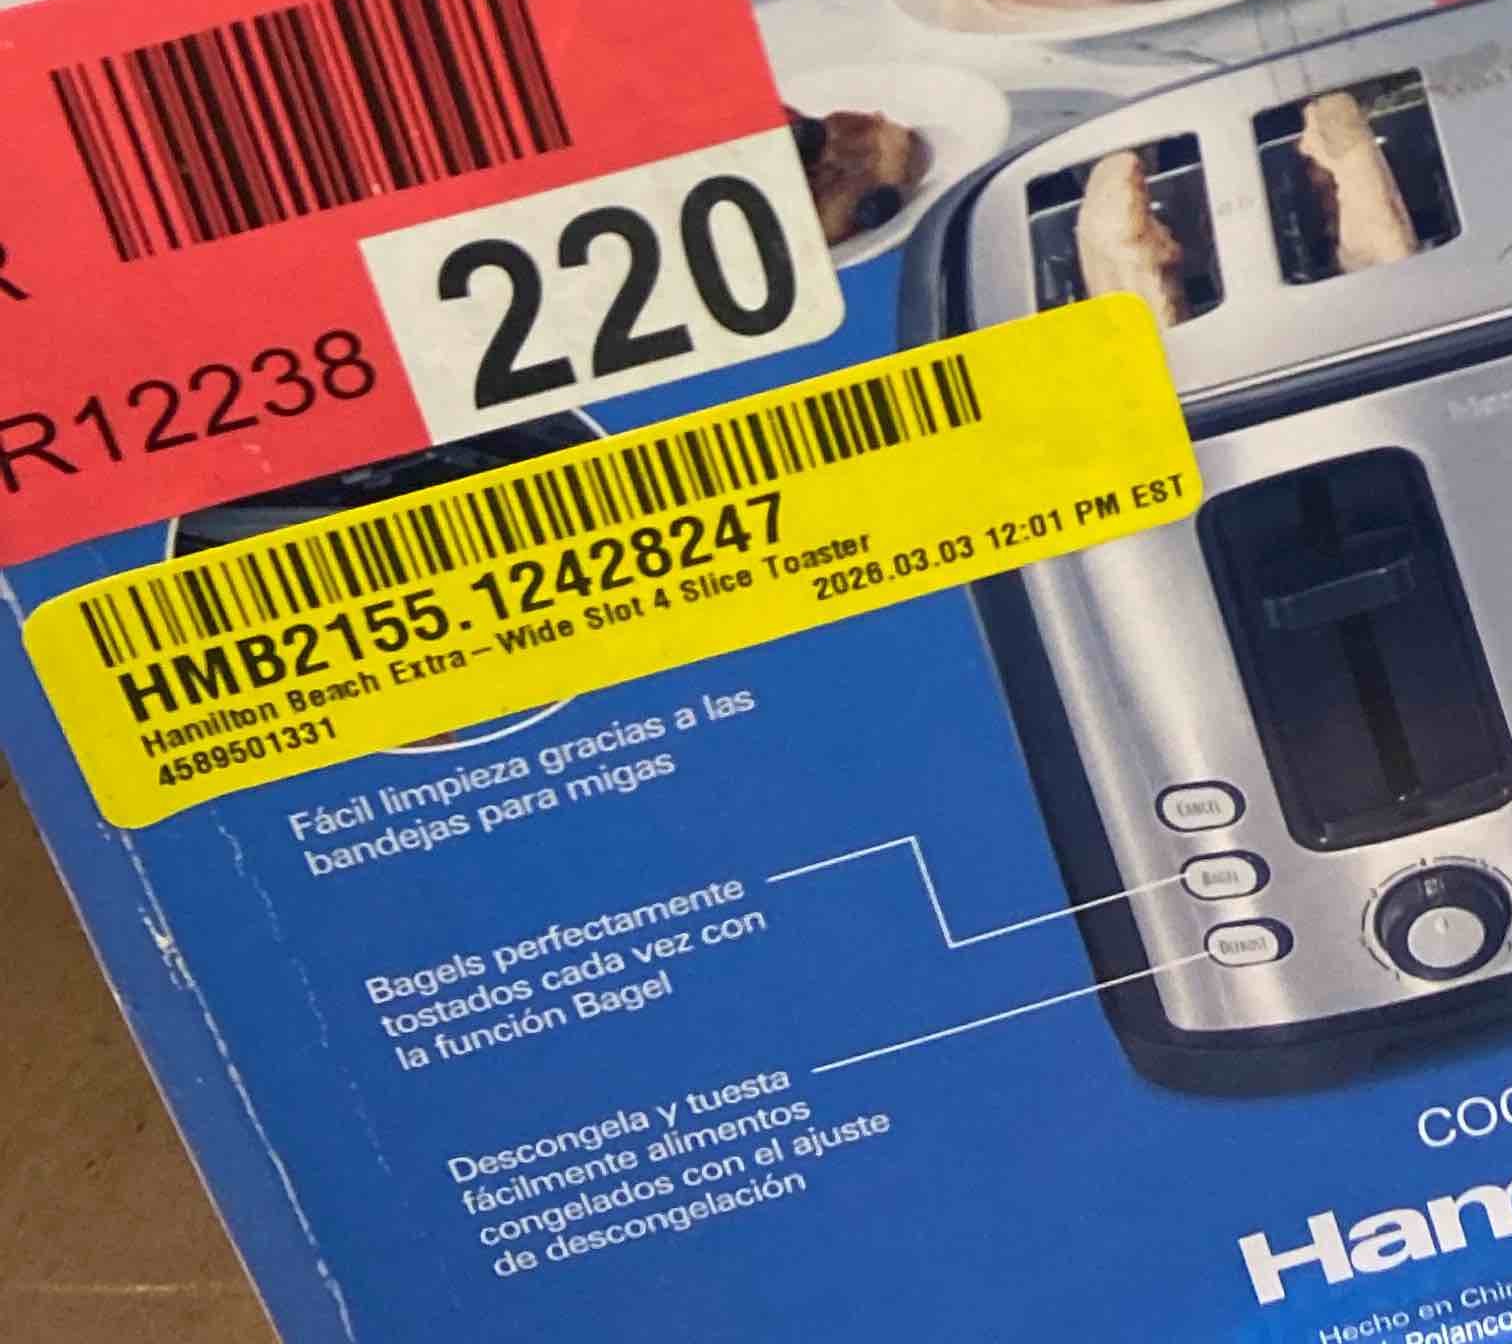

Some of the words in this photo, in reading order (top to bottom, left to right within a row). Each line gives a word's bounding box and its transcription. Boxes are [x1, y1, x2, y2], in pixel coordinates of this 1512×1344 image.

[437, 173, 797, 410] 220
[812, 535, 974, 600] 2026.03.03
[985, 510, 1063, 550] 12:01
[1074, 491, 1121, 526] PM
[1131, 473, 1184, 509] EST
[118, 491, 782, 723] HMB2155.12428247
[140, 700, 278, 758] Hamilton
[286, 672, 381, 713] Beach
[583, 596, 645, 630] Slot
[653, 588, 671, 610] 4
[679, 570, 753, 604] Slice
[762, 532, 871, 580] Toaster
[158, 716, 337, 785] 4589501331
[288, 796, 375, 842] Fácil
[380, 754, 530, 818] limpieza
[539, 714, 666, 774] gracias
[675, 707, 697, 731] a
[703, 686, 755, 721] las
[305, 811, 470, 877] bandejas
[477, 788, 557, 833] para
[567, 748, 675, 800] migas
[365, 951, 485, 1005] Bagels
[495, 875, 745, 971] perfectamente
[381, 976, 533, 1039] tostados
[541, 949, 625, 993] cada
[632, 933, 692, 965] vez
[701, 908, 767, 945] con
[395, 1045, 429, 1072] la
[435, 1006, 567, 1061] función
[573, 971, 673, 1021] Bagel
[447, 1109, 649, 1184] Descongela
[657, 1101, 677, 1129] y
[687, 1069, 790, 1114] tuesta
[462, 1146, 639, 1216] fácilmente
[648, 1098, 811, 1162] alimentos
[479, 1170, 674, 1246] congelados
[683, 1154, 745, 1187] con
[754, 1137, 783, 1167] el
[793, 1112, 891, 1158] ajuste
[493, 1247, 537, 1278] de
[545, 1171, 807, 1262] descongelación
[1319, 1312, 1410, 1344] Hecho
[1418, 1300, 1453, 1320] en
